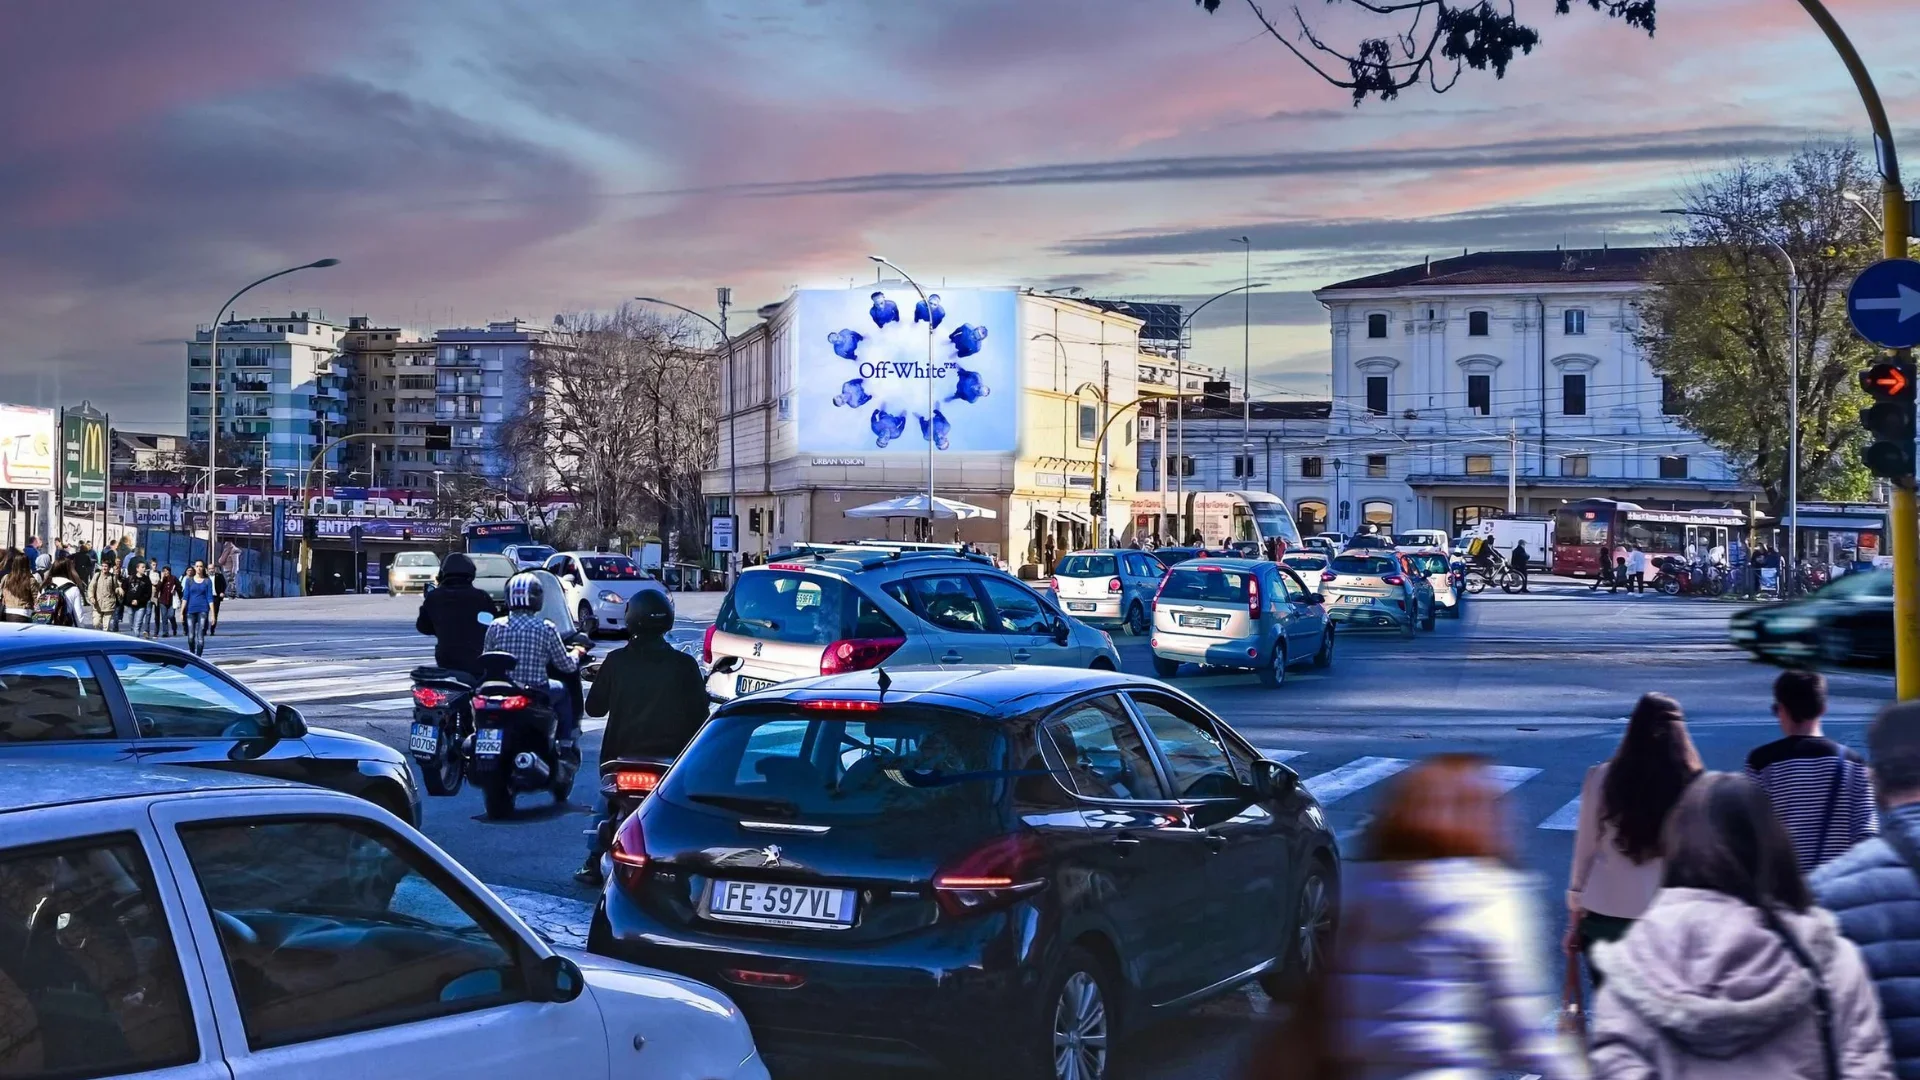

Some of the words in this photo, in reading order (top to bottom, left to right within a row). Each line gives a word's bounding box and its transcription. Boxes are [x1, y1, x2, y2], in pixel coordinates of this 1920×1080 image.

[741, 678, 753, 693] DY
[411, 737, 436, 752] 00706
[476, 741, 501, 751] 99262
[726, 883, 756, 911] FE
[762, 886, 836, 919] 597VL
